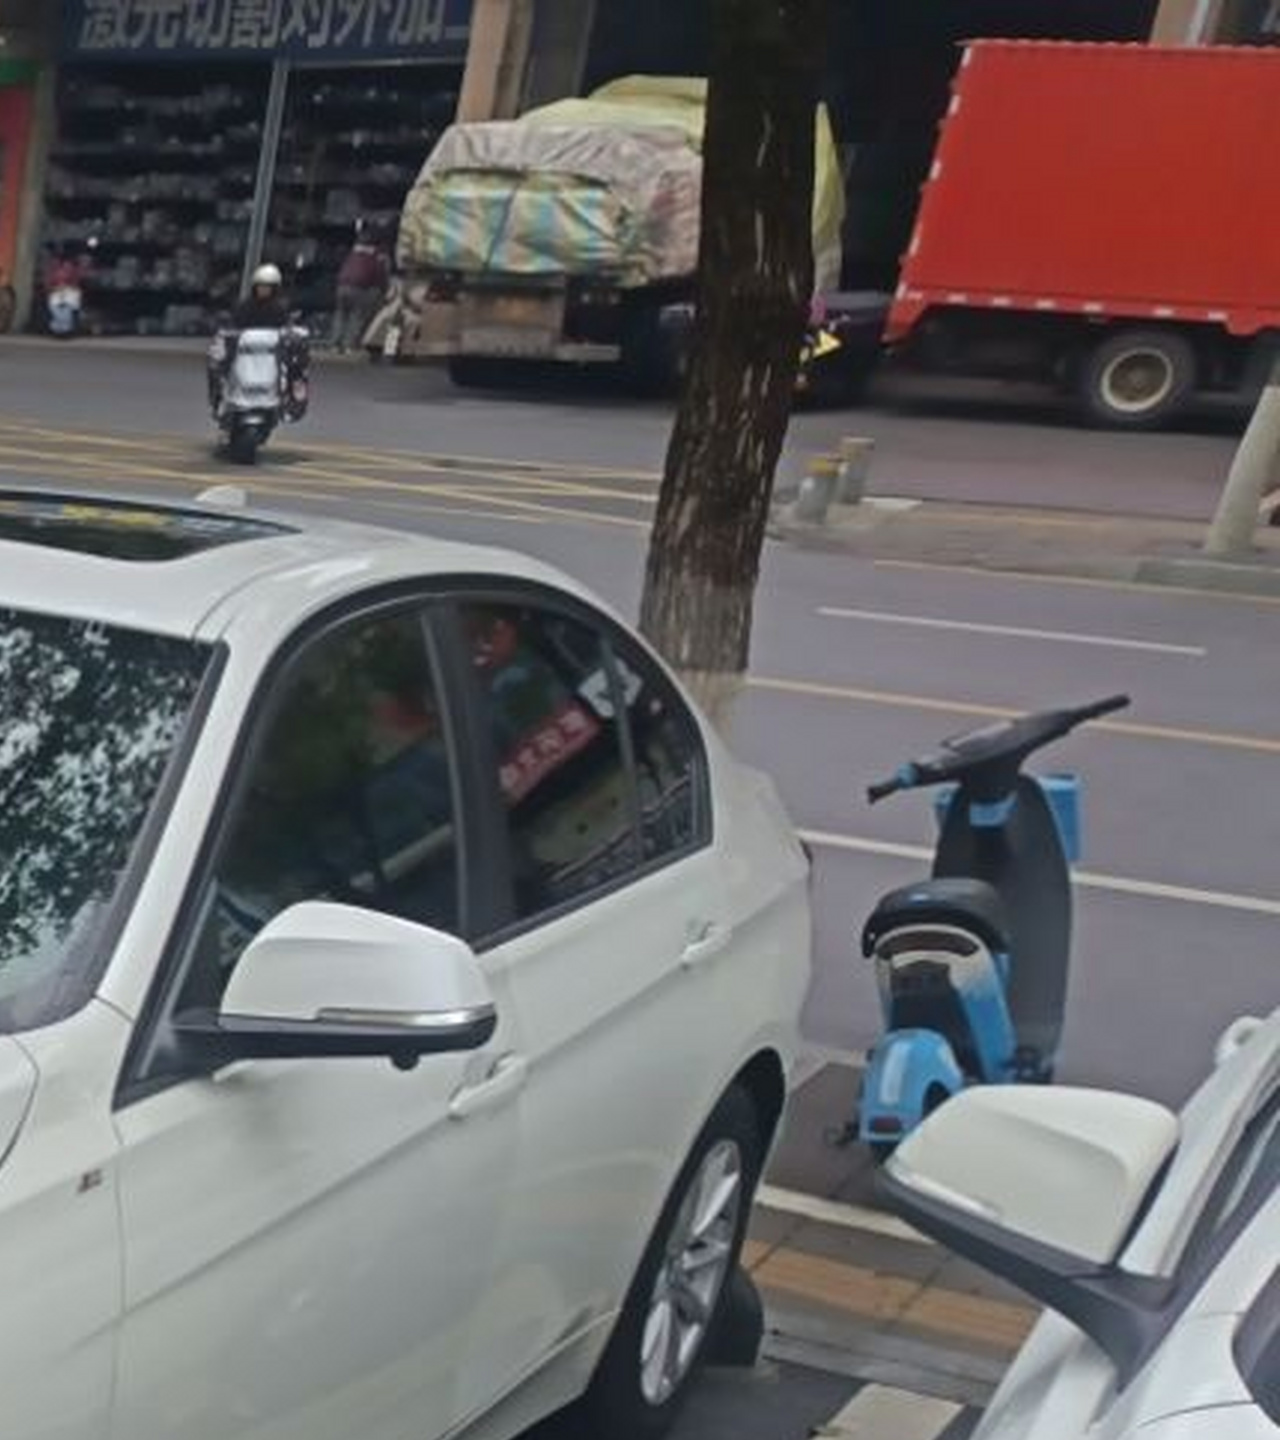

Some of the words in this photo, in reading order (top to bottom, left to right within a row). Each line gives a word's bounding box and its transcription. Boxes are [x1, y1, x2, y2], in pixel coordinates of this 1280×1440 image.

[78, 0, 470, 50] 激光切割对外加
